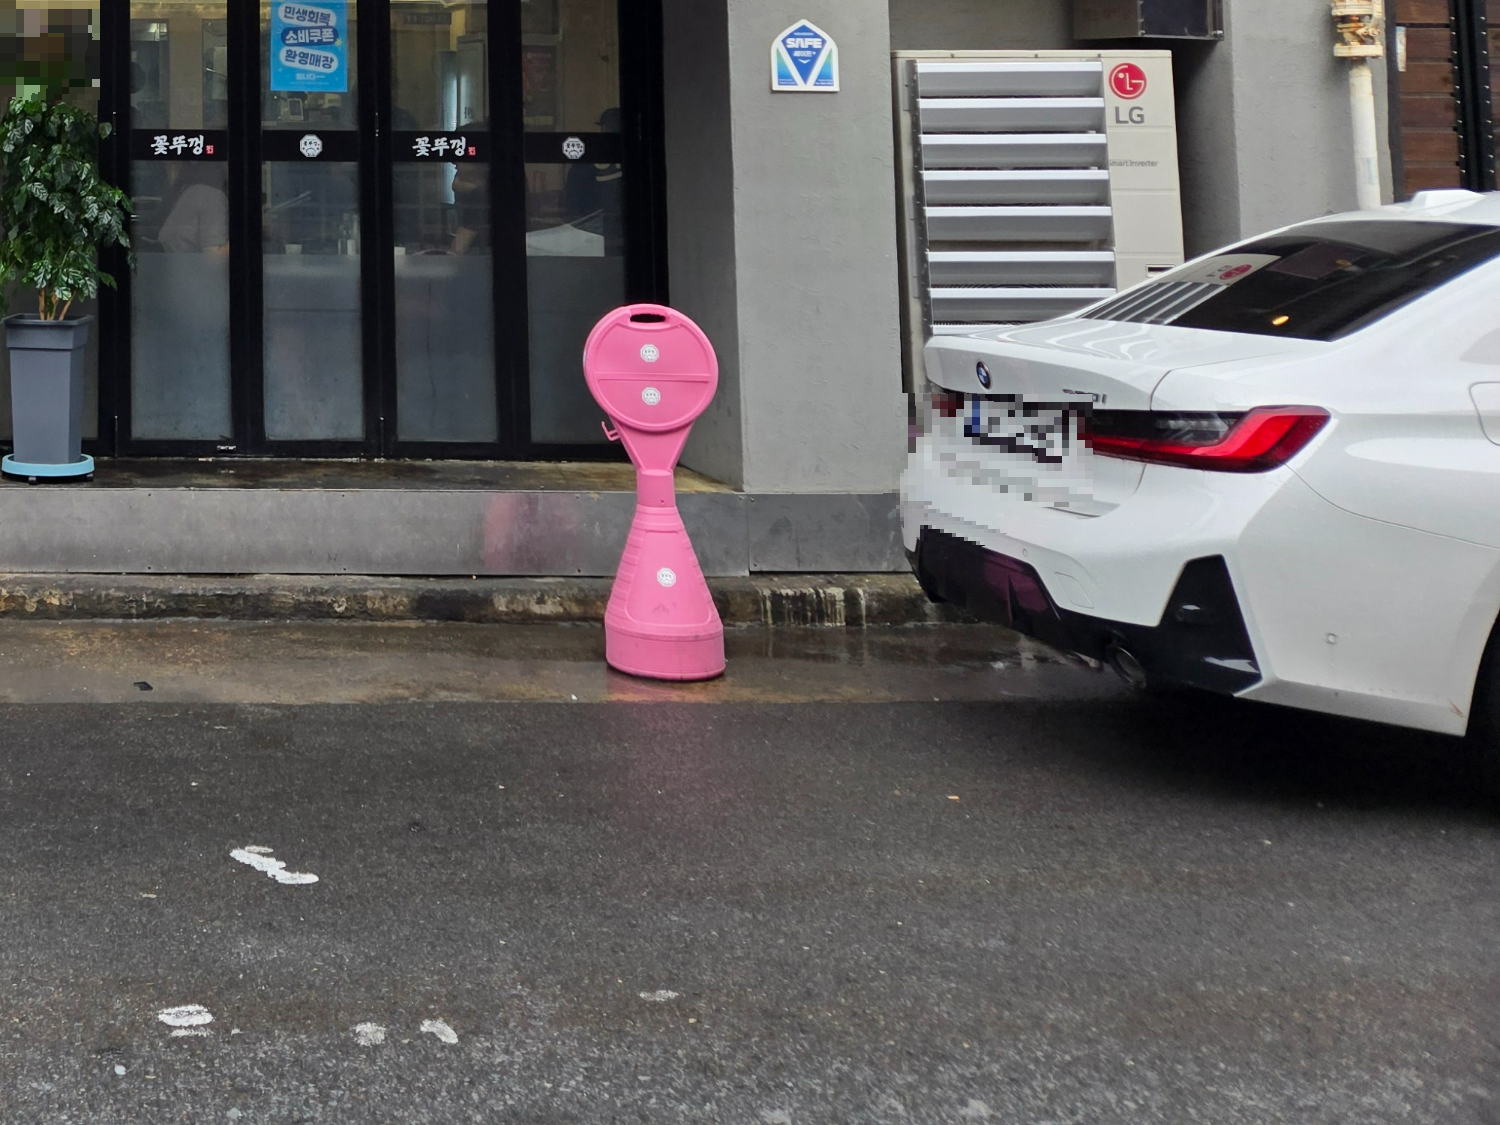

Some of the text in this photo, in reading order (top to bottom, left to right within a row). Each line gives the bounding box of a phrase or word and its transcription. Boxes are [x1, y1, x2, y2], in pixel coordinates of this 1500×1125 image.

[283, 5, 331, 26] 민생회복
[285, 28, 334, 44] 소비쿠폰
[785, 37, 823, 49] SAFE
[285, 49, 335, 70] 환영매장
[1114, 106, 1145, 124] LG
[150, 134, 204, 156] 꽃뚜껑
[412, 136, 466, 157] 꽃뚜껑
